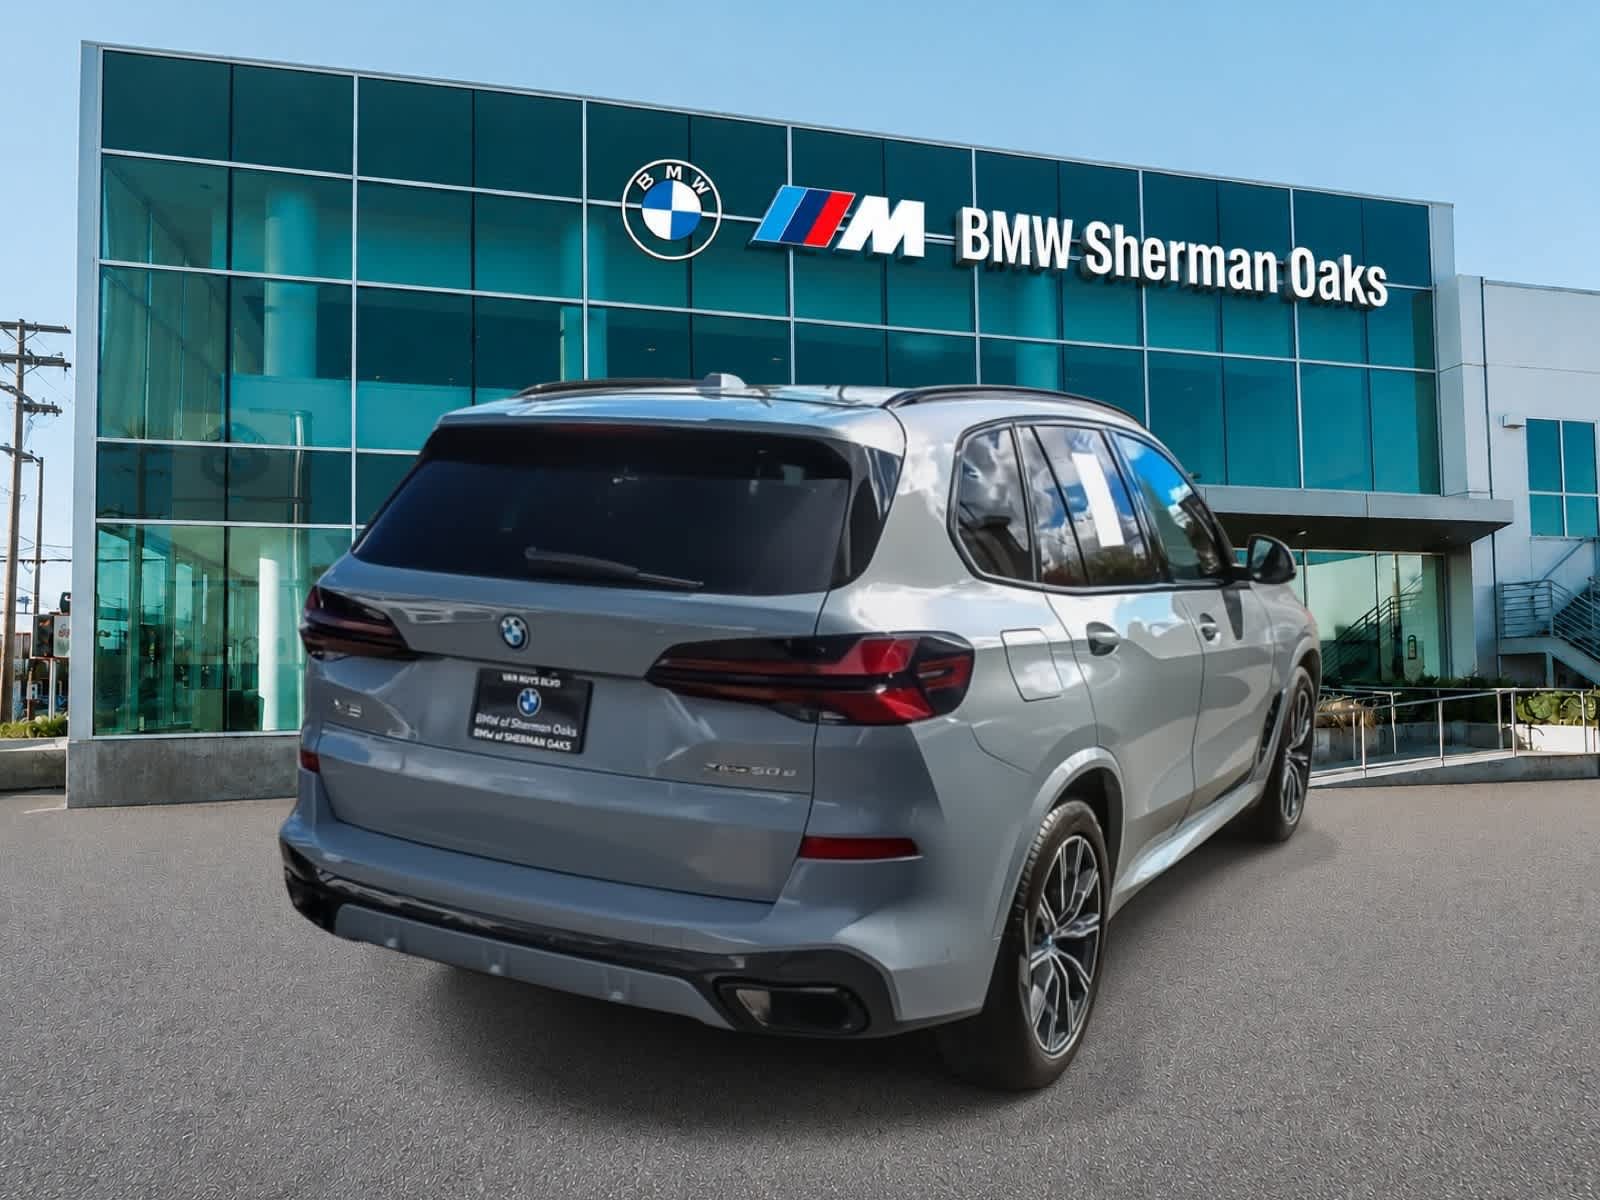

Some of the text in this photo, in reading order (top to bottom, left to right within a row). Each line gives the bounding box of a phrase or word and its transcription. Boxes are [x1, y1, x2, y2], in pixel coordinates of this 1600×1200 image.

[636, 165, 711, 195] BMW
[961, 206, 1388, 307] BMW Sherman Oaks
[475, 713, 577, 737] BMW of Sherman Oaks
[474, 728, 494, 739] BMW
[504, 733, 545, 747] SHERMAN
[546, 739, 571, 751] OAKS
